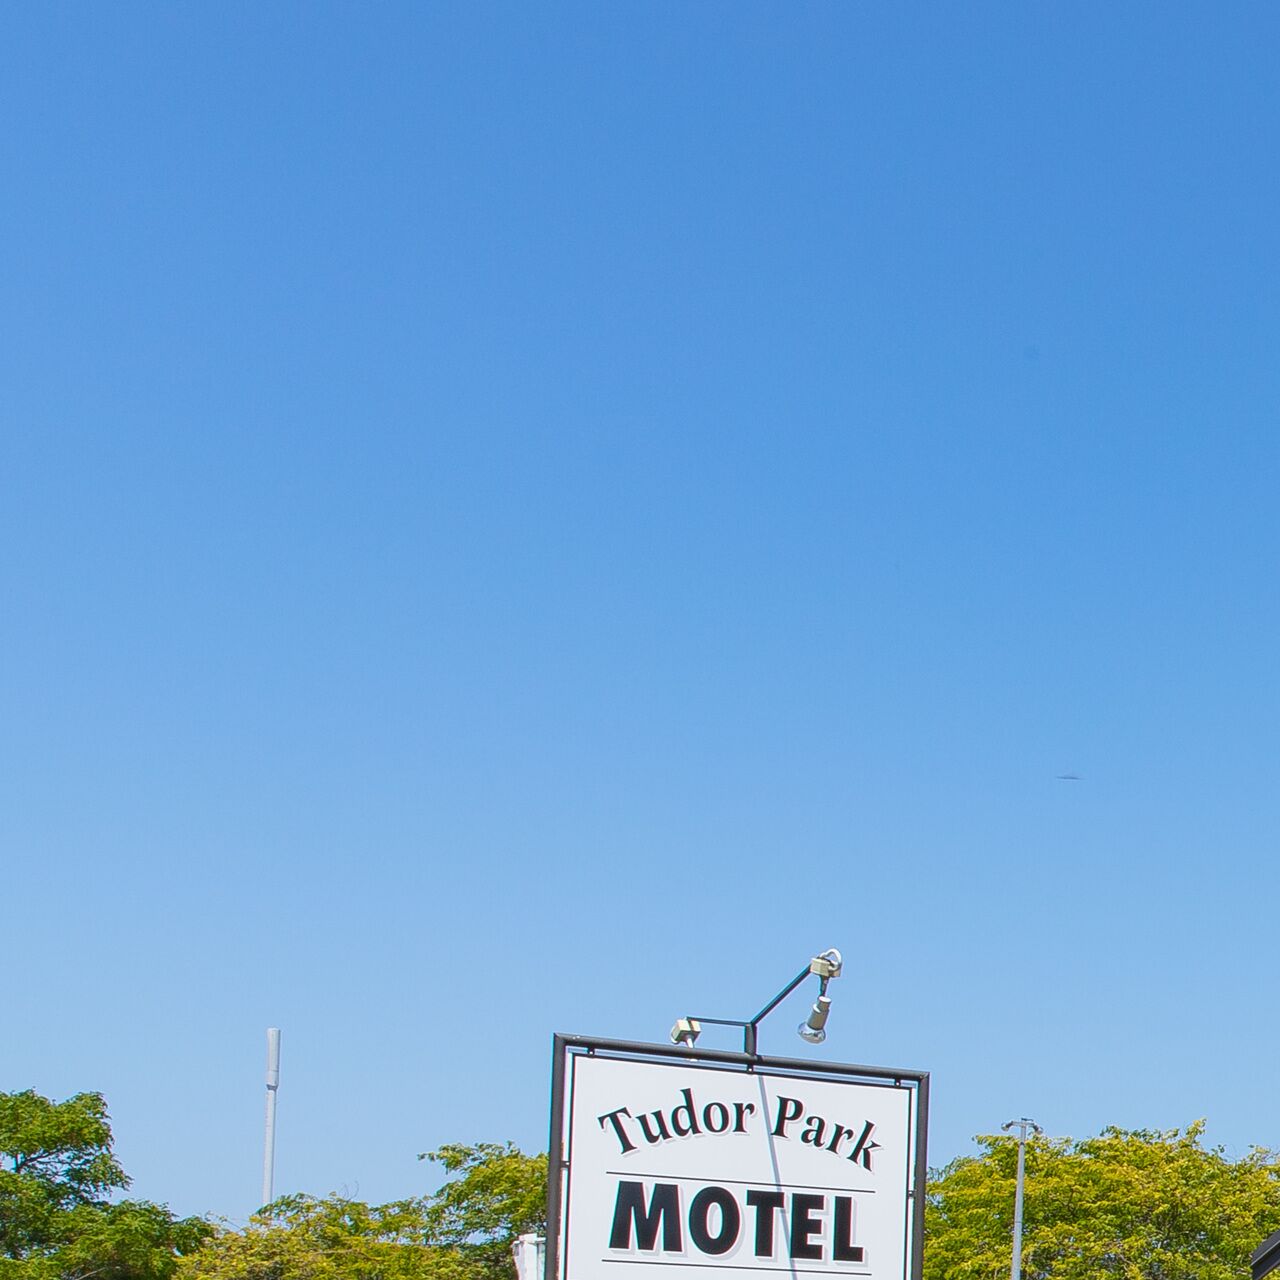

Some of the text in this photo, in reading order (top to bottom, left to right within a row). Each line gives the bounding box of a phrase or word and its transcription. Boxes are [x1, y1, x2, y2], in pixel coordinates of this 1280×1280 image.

[598, 1088, 882, 1171] Tudor Park
[608, 1180, 865, 1263] MOTEL
